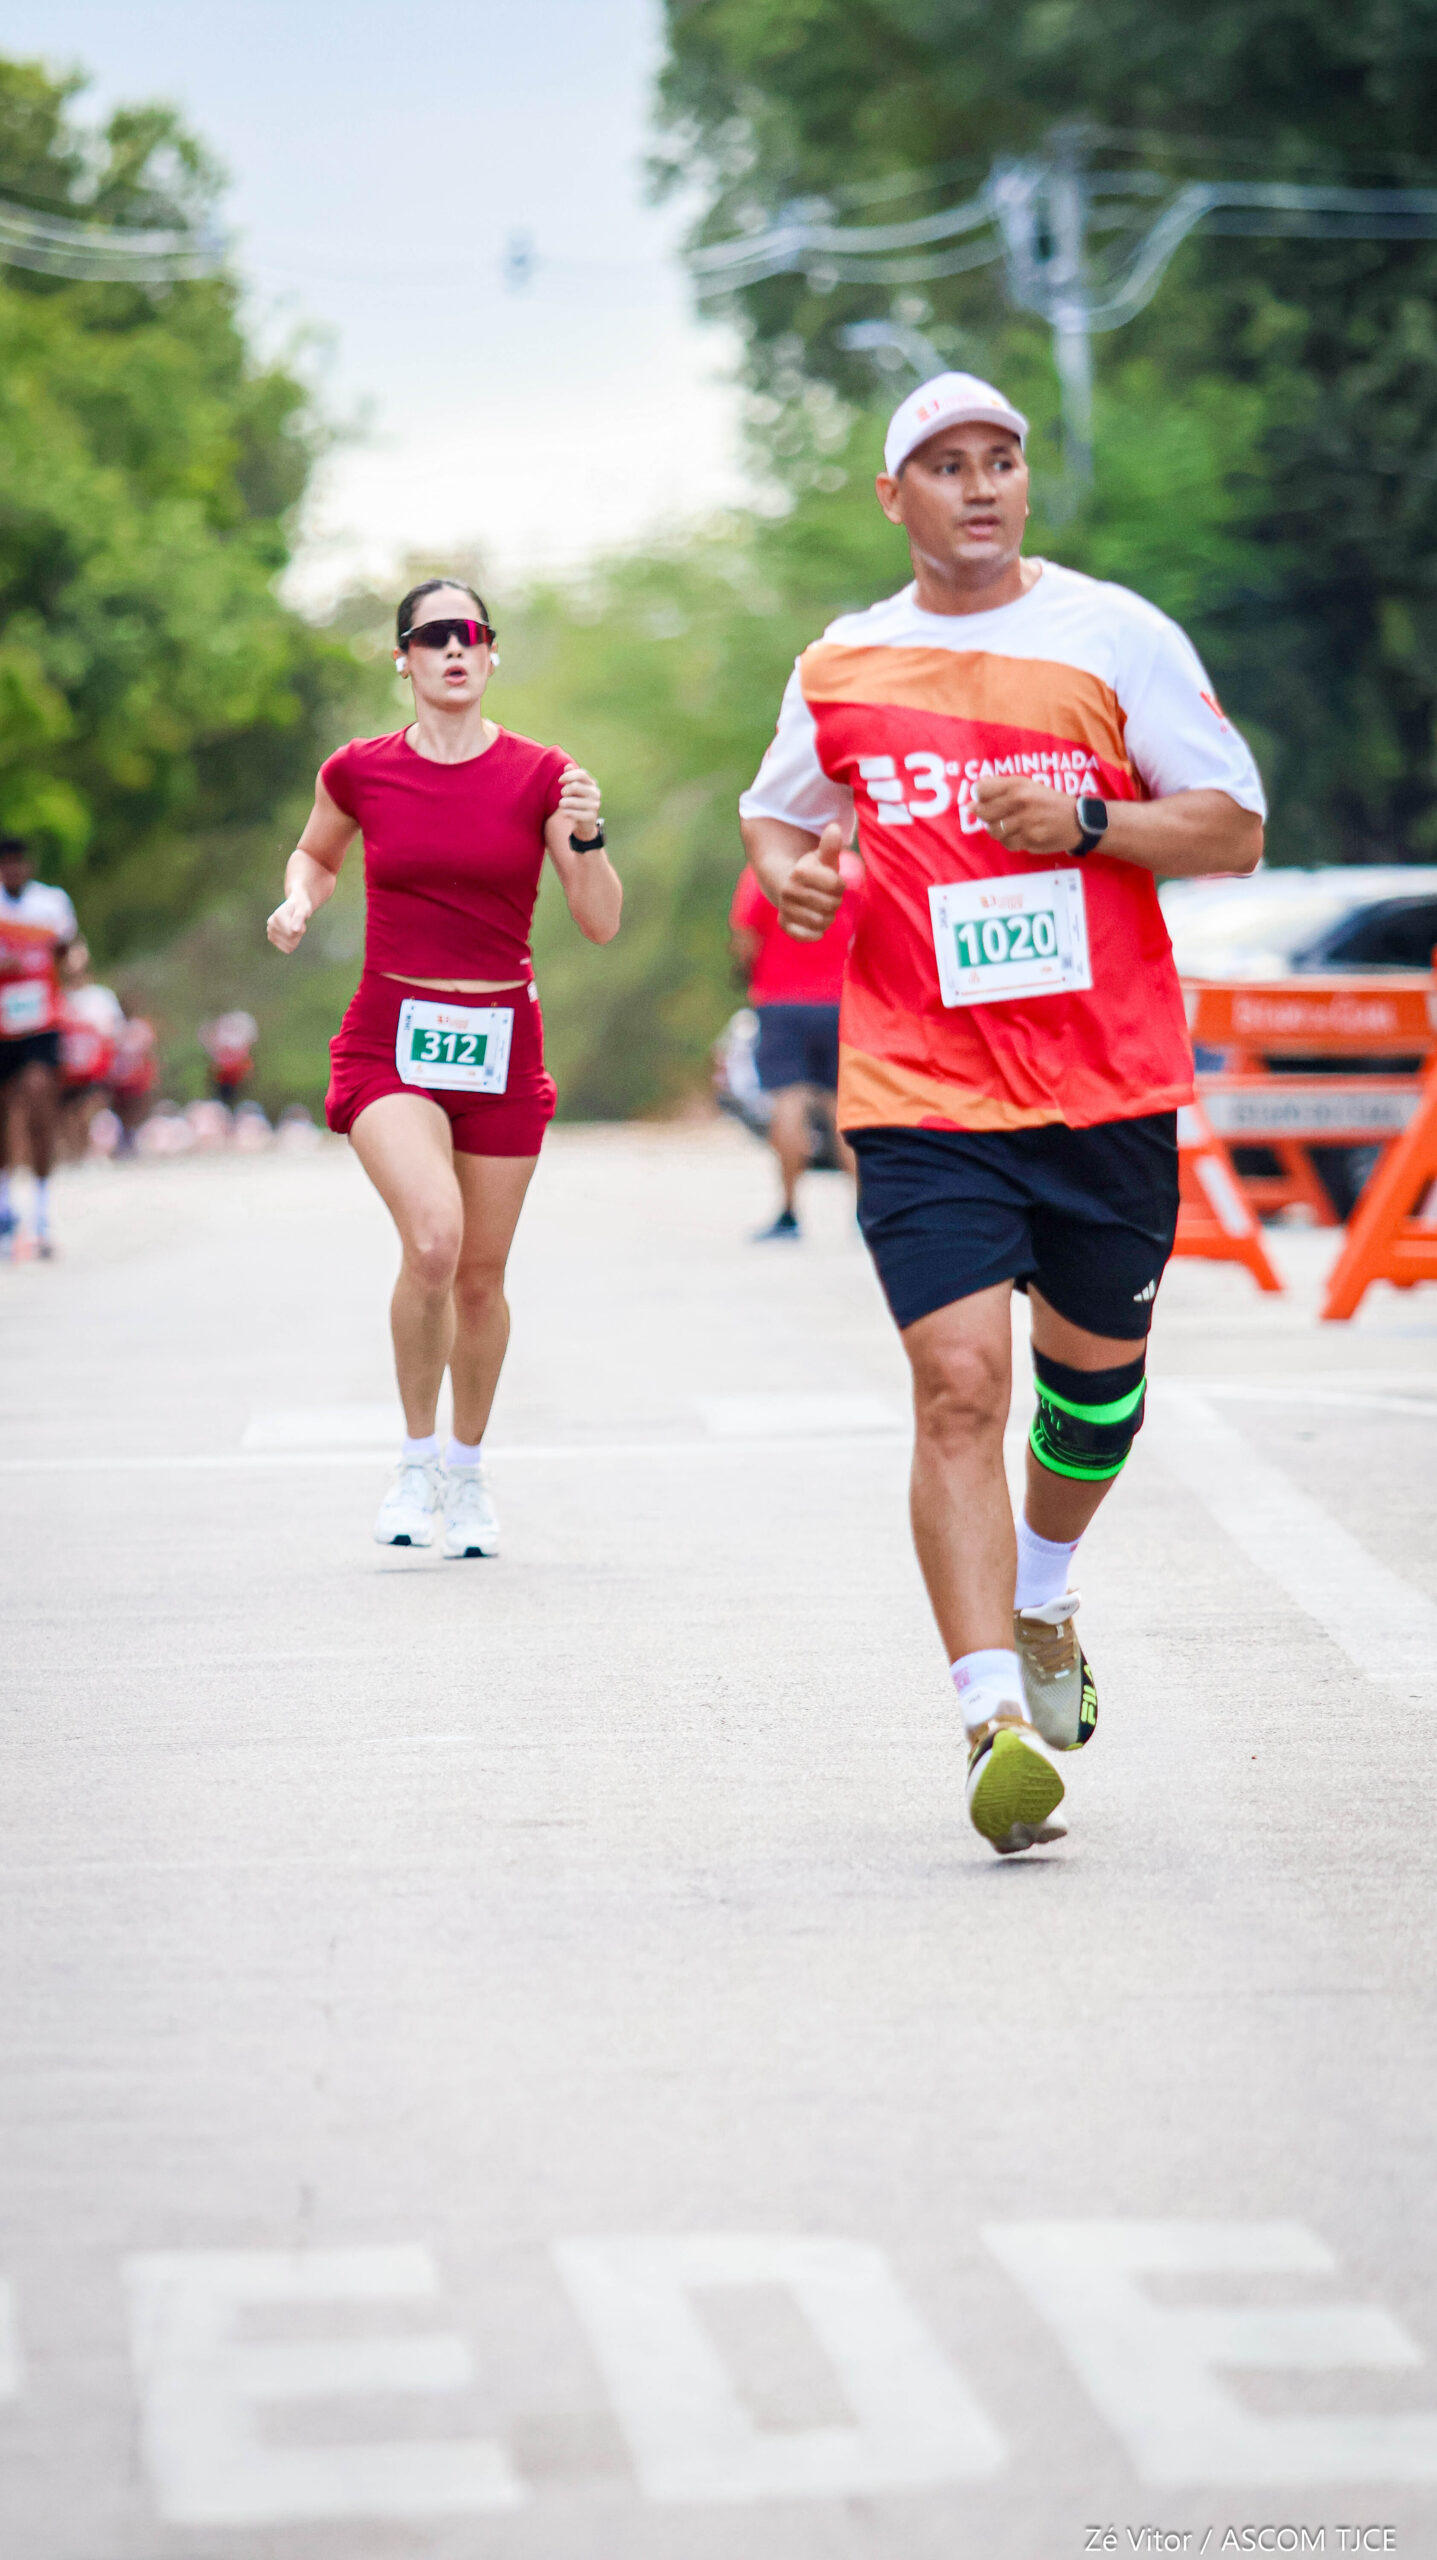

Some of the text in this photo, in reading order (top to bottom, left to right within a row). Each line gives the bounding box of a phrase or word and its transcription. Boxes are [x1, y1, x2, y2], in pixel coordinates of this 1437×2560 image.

[964, 750, 1100, 779] CAMINHADA
[957, 912, 1056, 967] 1020
[420, 1031, 478, 1064] 312
[0, 2220, 1437, 2525] EDE
